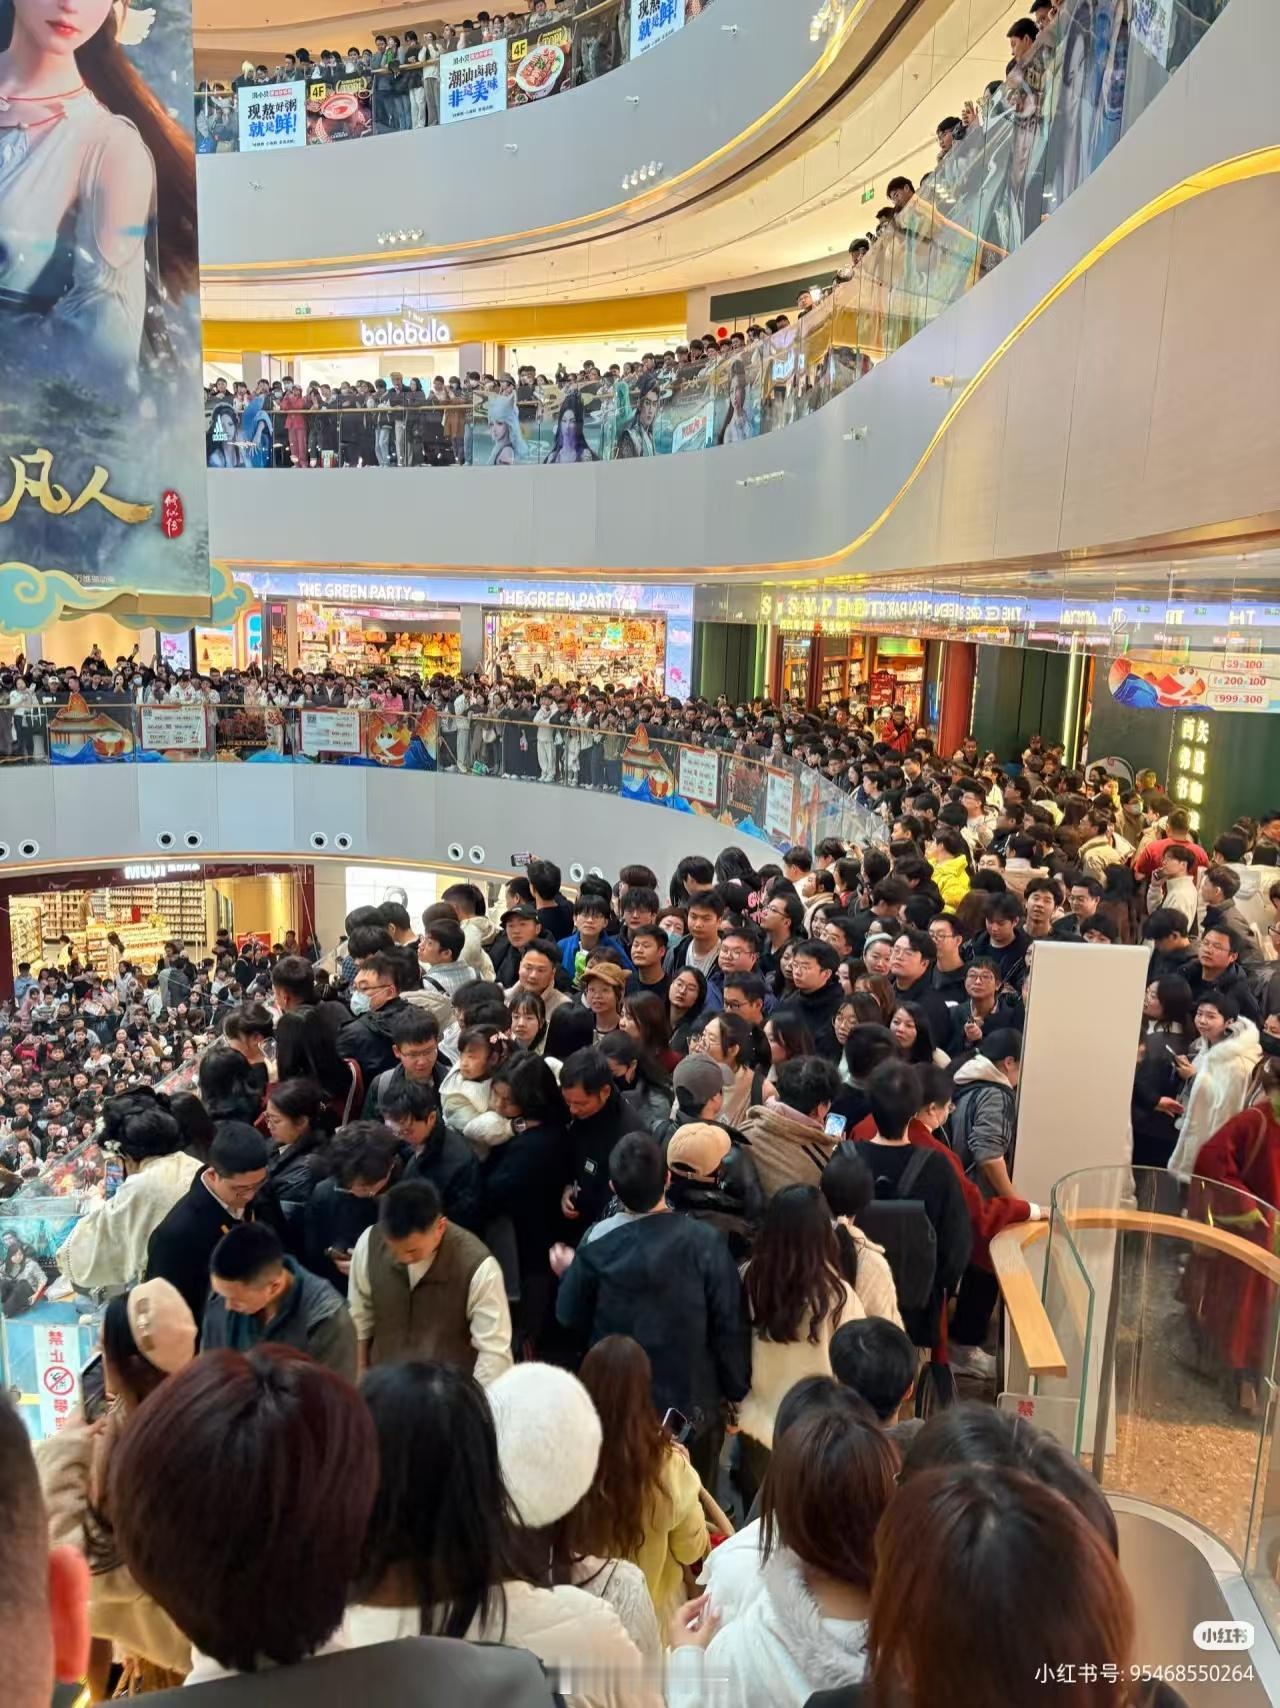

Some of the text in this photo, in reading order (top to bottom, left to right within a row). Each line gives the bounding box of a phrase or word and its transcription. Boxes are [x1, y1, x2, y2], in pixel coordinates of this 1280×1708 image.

[514, 43, 526, 55] 4F
[312, 86, 325, 98] 4F
[249, 112, 297, 137] 就是鲜!
[298, 583, 412, 600] THE GREEN PARTY
[526, 590, 576, 609] GREEN
[580, 591, 621, 610] PARTY
[125, 865, 166, 880] MUJI
